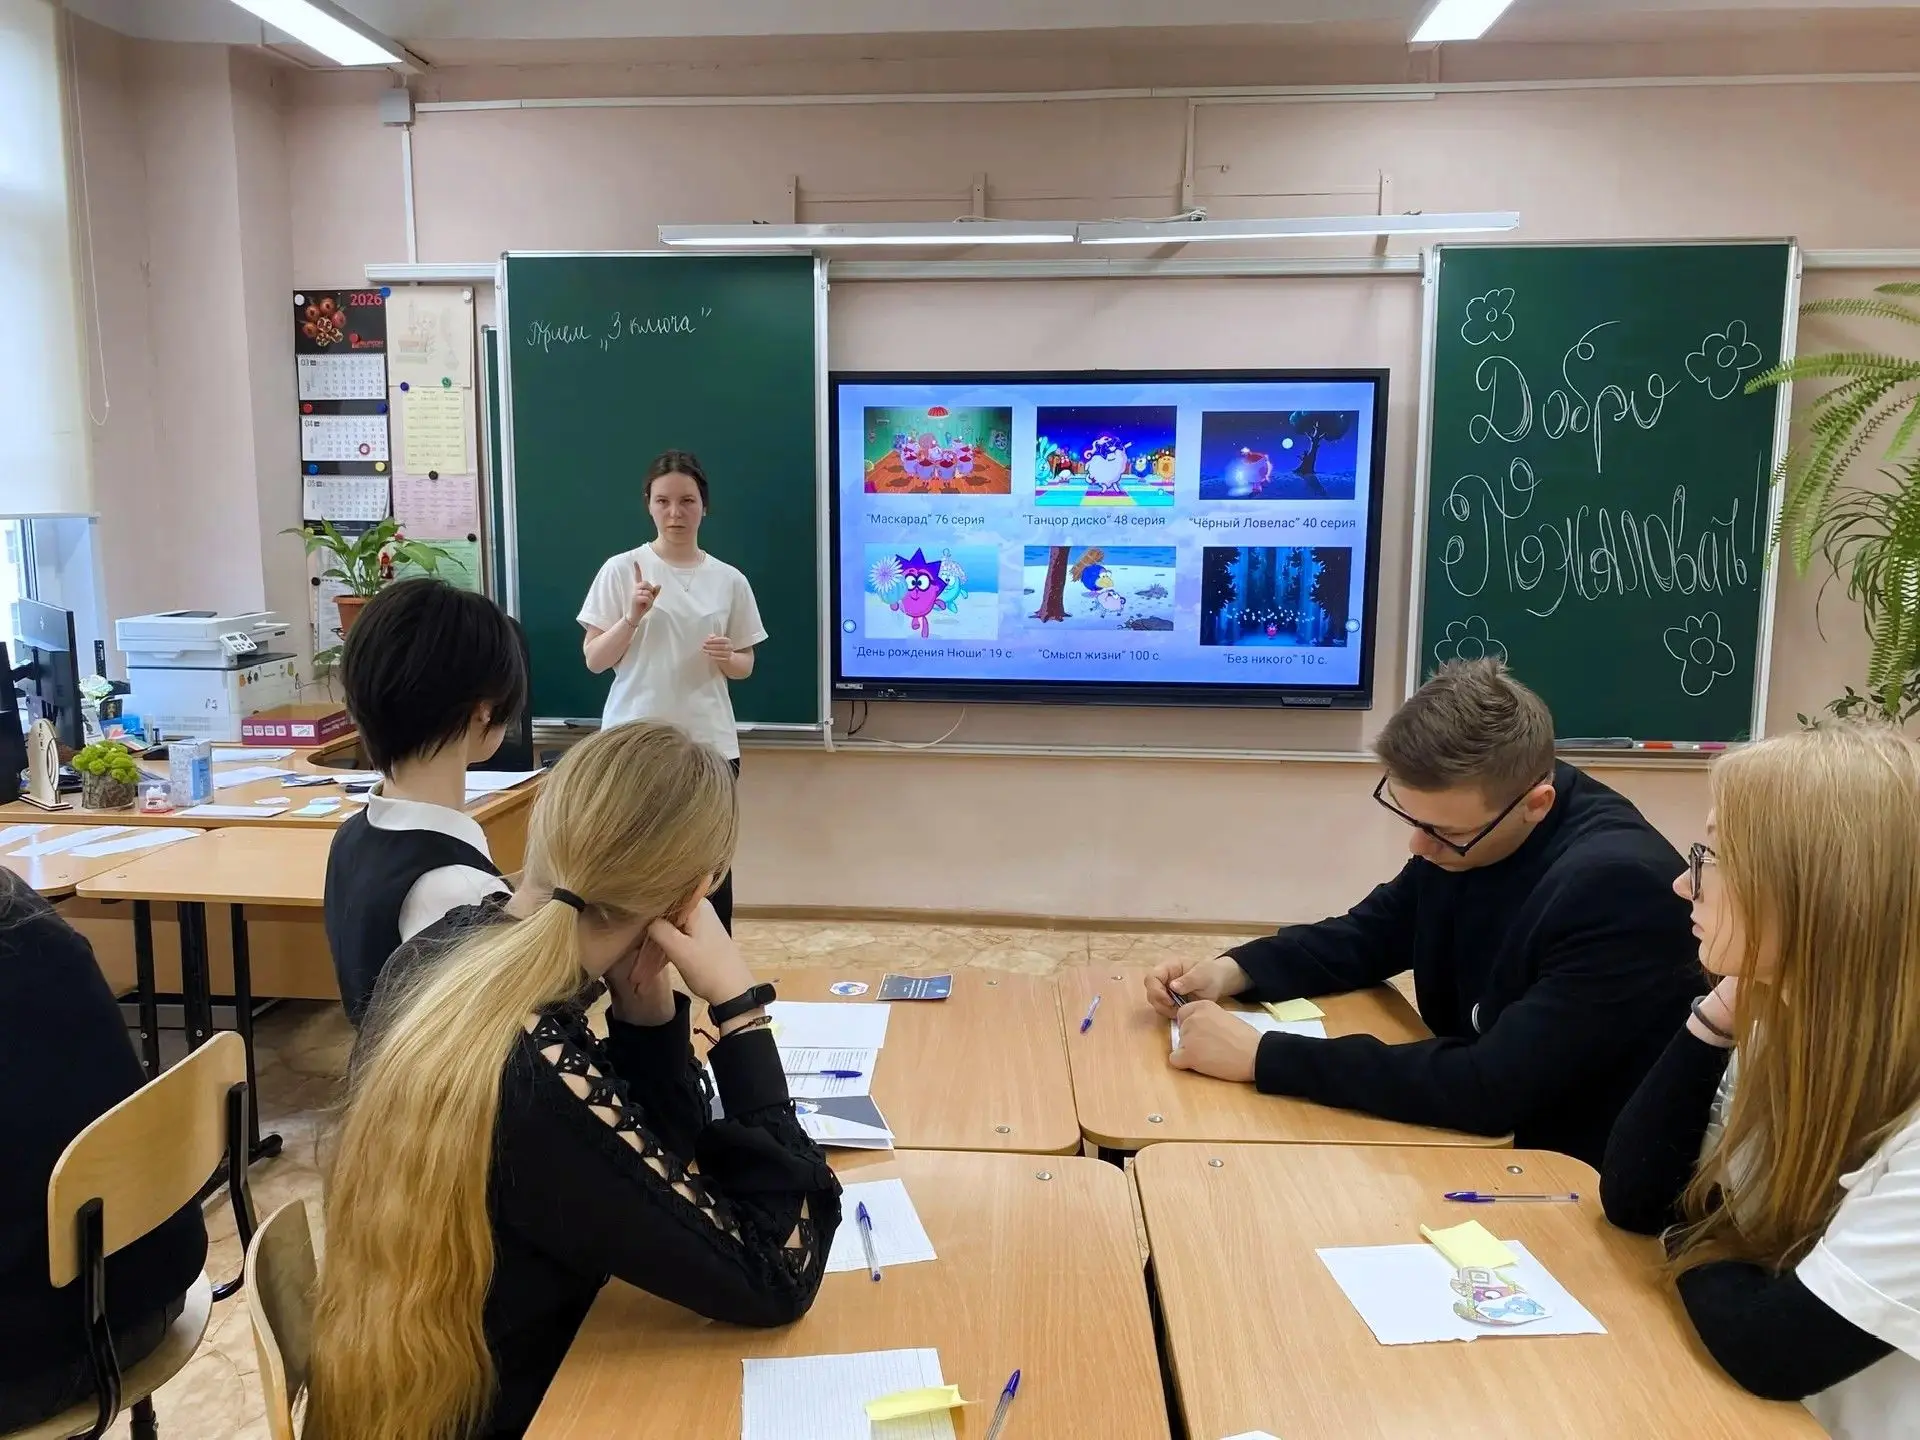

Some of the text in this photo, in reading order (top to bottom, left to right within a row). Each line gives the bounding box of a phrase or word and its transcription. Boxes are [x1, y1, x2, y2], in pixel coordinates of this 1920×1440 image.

[350, 293, 383, 306] 2026
[1470, 320, 1681, 473] Добро
[866, 513, 985, 526] "Маскарад" 76 серия
[1022, 514, 1165, 527] "Танцор диско" 48 серия
[1189, 517, 1356, 530] "Чёрный Ловелас" 40 серия
[853, 645, 886, 658] "День
[888, 648, 944, 658] рождения
[947, 647, 987, 659] Нюши"
[990, 648, 1002, 658] 19
[1038, 648, 1082, 659] "Смысл
[1085, 650, 1127, 660] жизни"
[1129, 650, 1149, 660] 100
[1223, 653, 1328, 665] "Без никого" 10 с.
